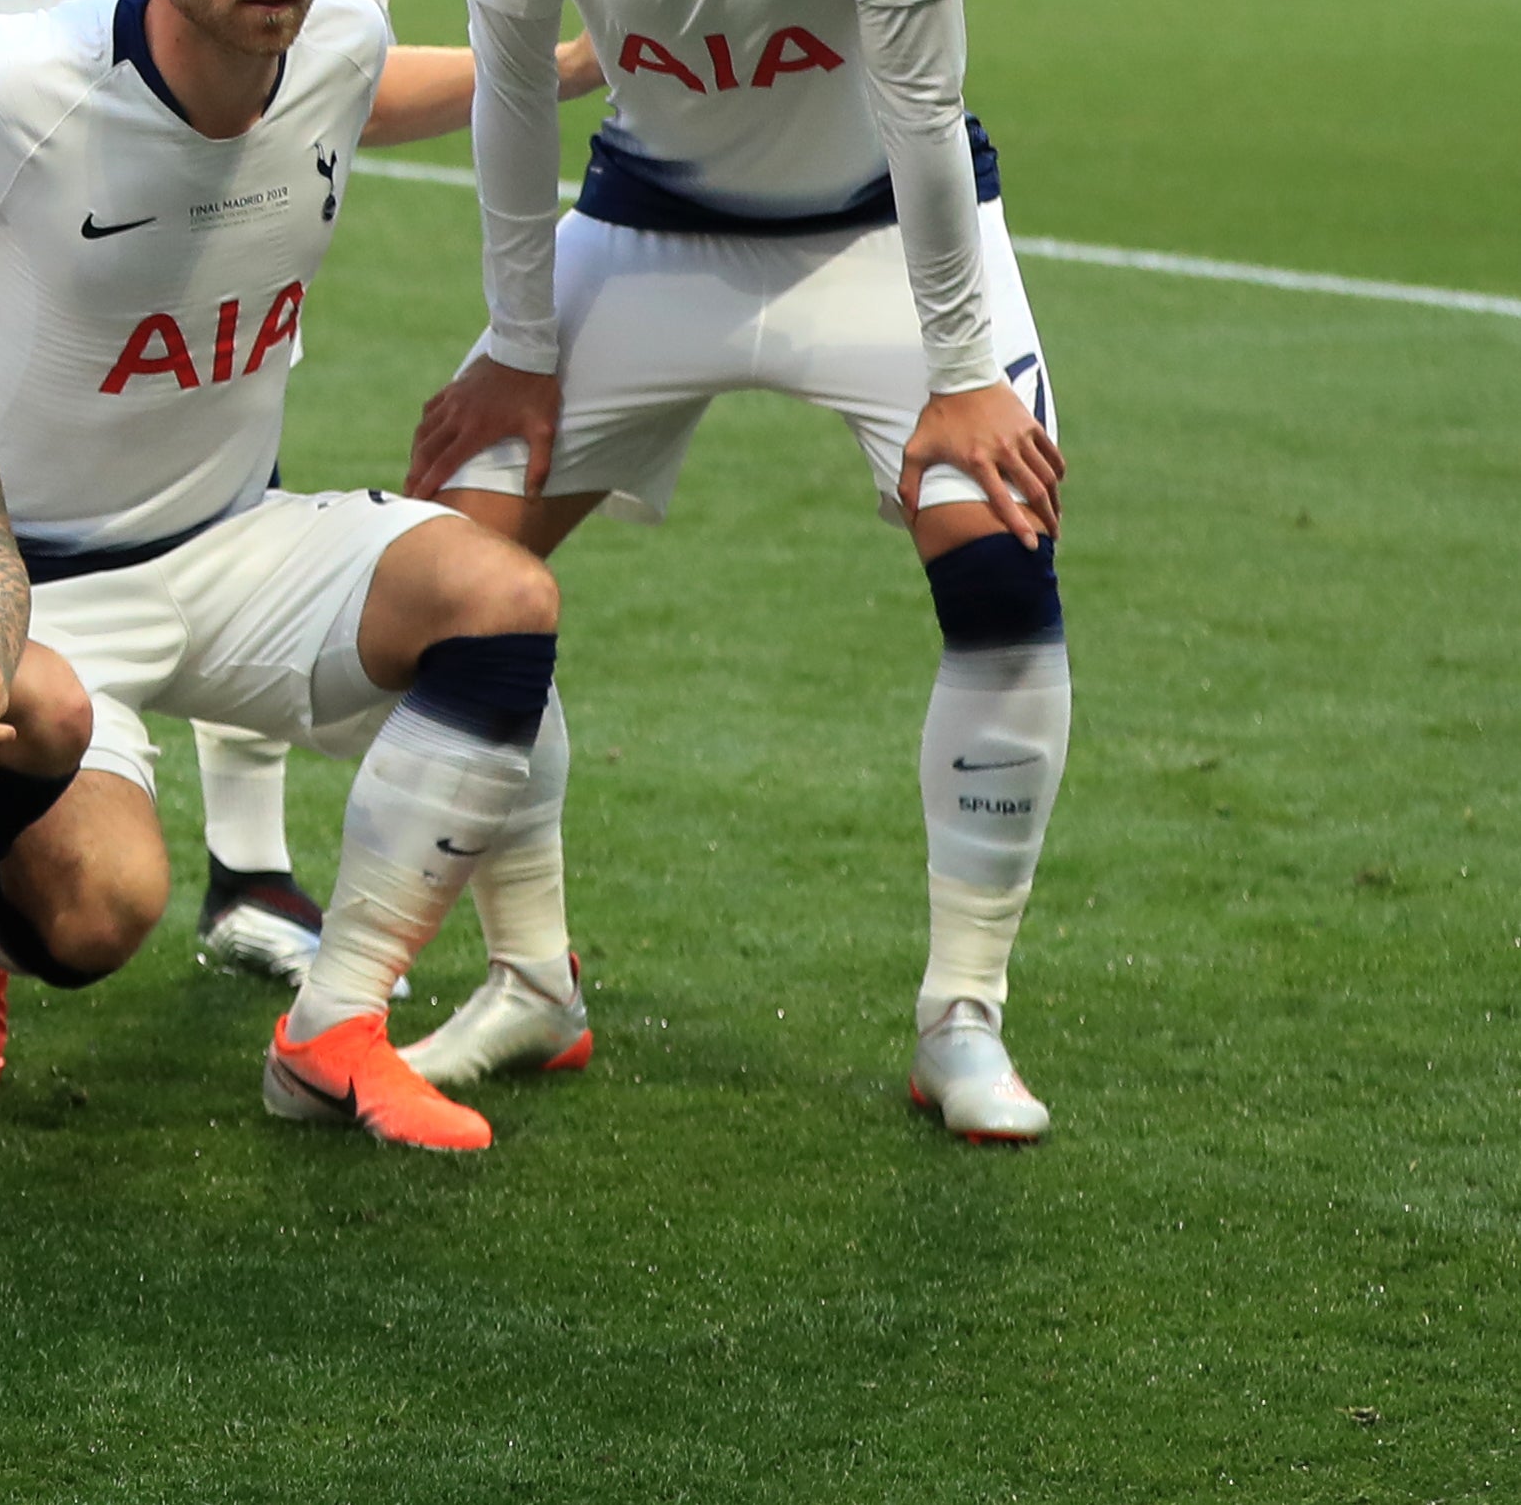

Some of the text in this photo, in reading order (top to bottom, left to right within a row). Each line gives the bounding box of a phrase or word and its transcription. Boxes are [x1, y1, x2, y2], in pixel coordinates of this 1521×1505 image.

[618, 26, 846, 95] AIA
[190, 203, 222, 218] FINAL
[223, 194, 264, 210] MADRID
[267, 186, 288, 201] 2019
[98, 280, 305, 395] AIA
[959, 797, 1032, 815] SPURS
